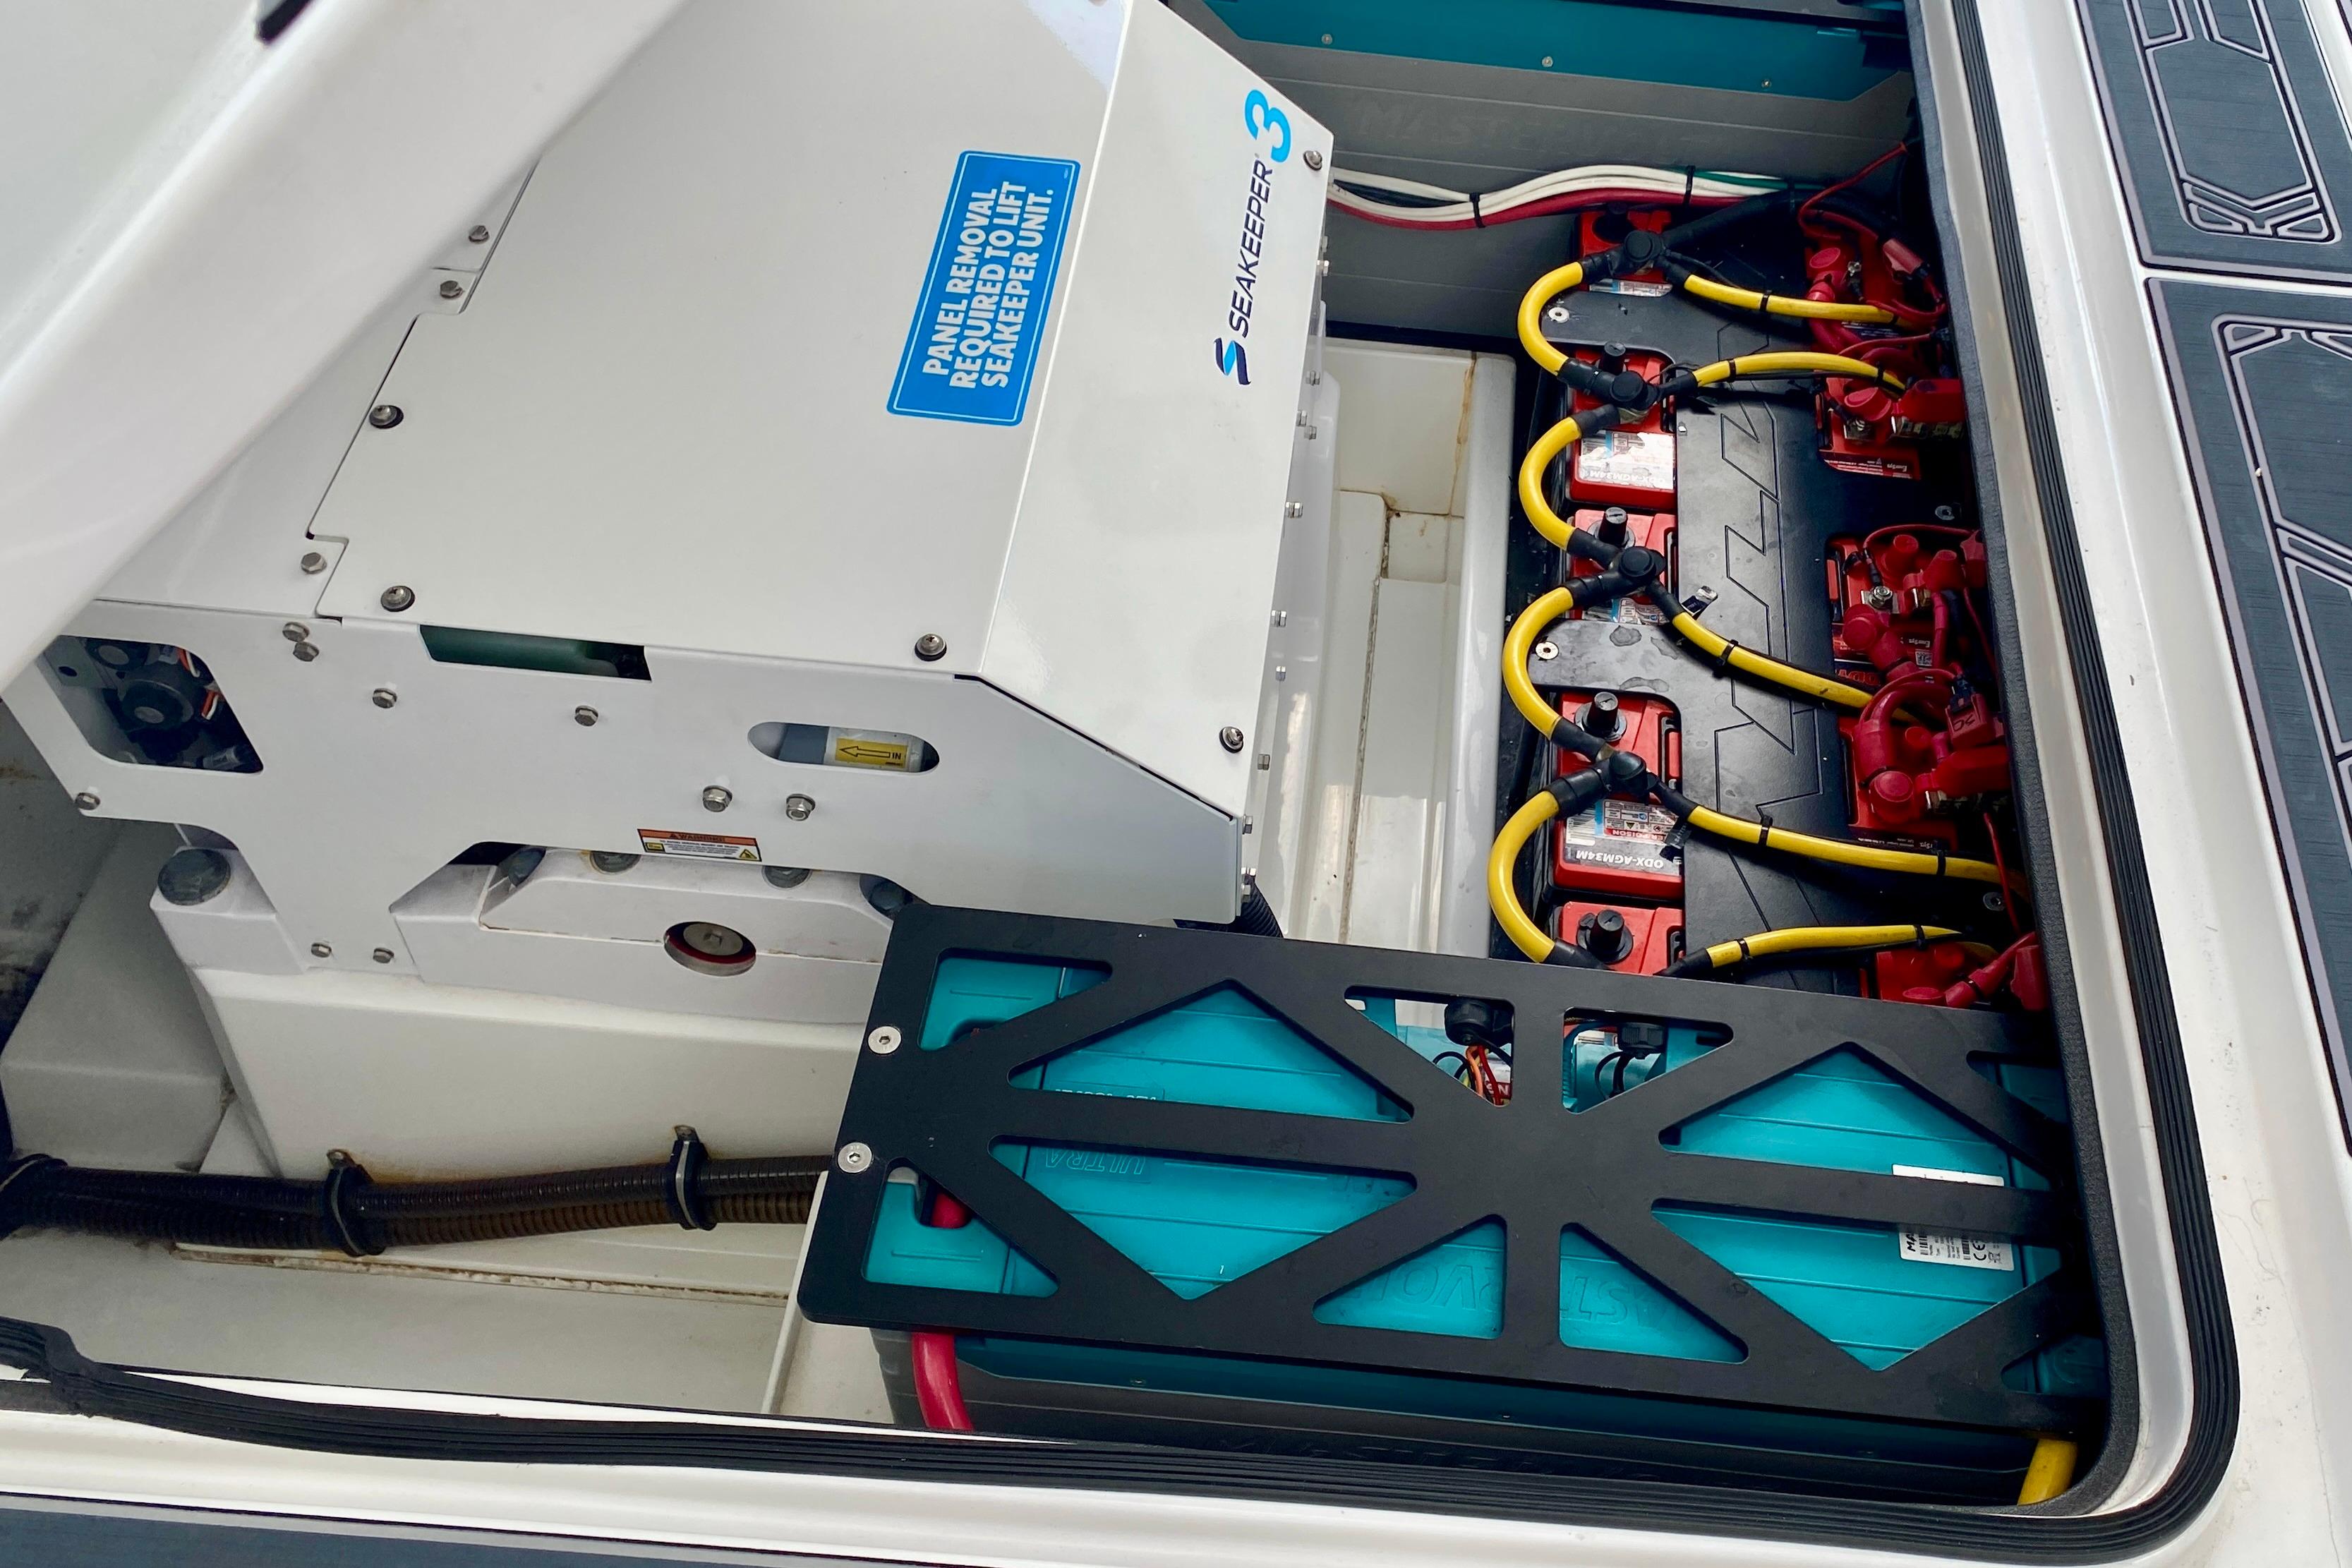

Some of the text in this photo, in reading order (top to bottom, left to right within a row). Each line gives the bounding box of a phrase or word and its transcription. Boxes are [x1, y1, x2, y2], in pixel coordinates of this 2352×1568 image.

[923, 189, 996, 374] PANEL REMOVAL
[950, 181, 1025, 387] REQUIRED TO LIFT
[982, 190, 1054, 387] SEAKEEPER UNIT.
[1228, 89, 1292, 339] SEAKEEPER 3
[1589, 470, 1666, 487] ODX-AGM34M
[891, 751, 903, 761] IN
[1576, 850, 1664, 869] ODX-AGM34M
